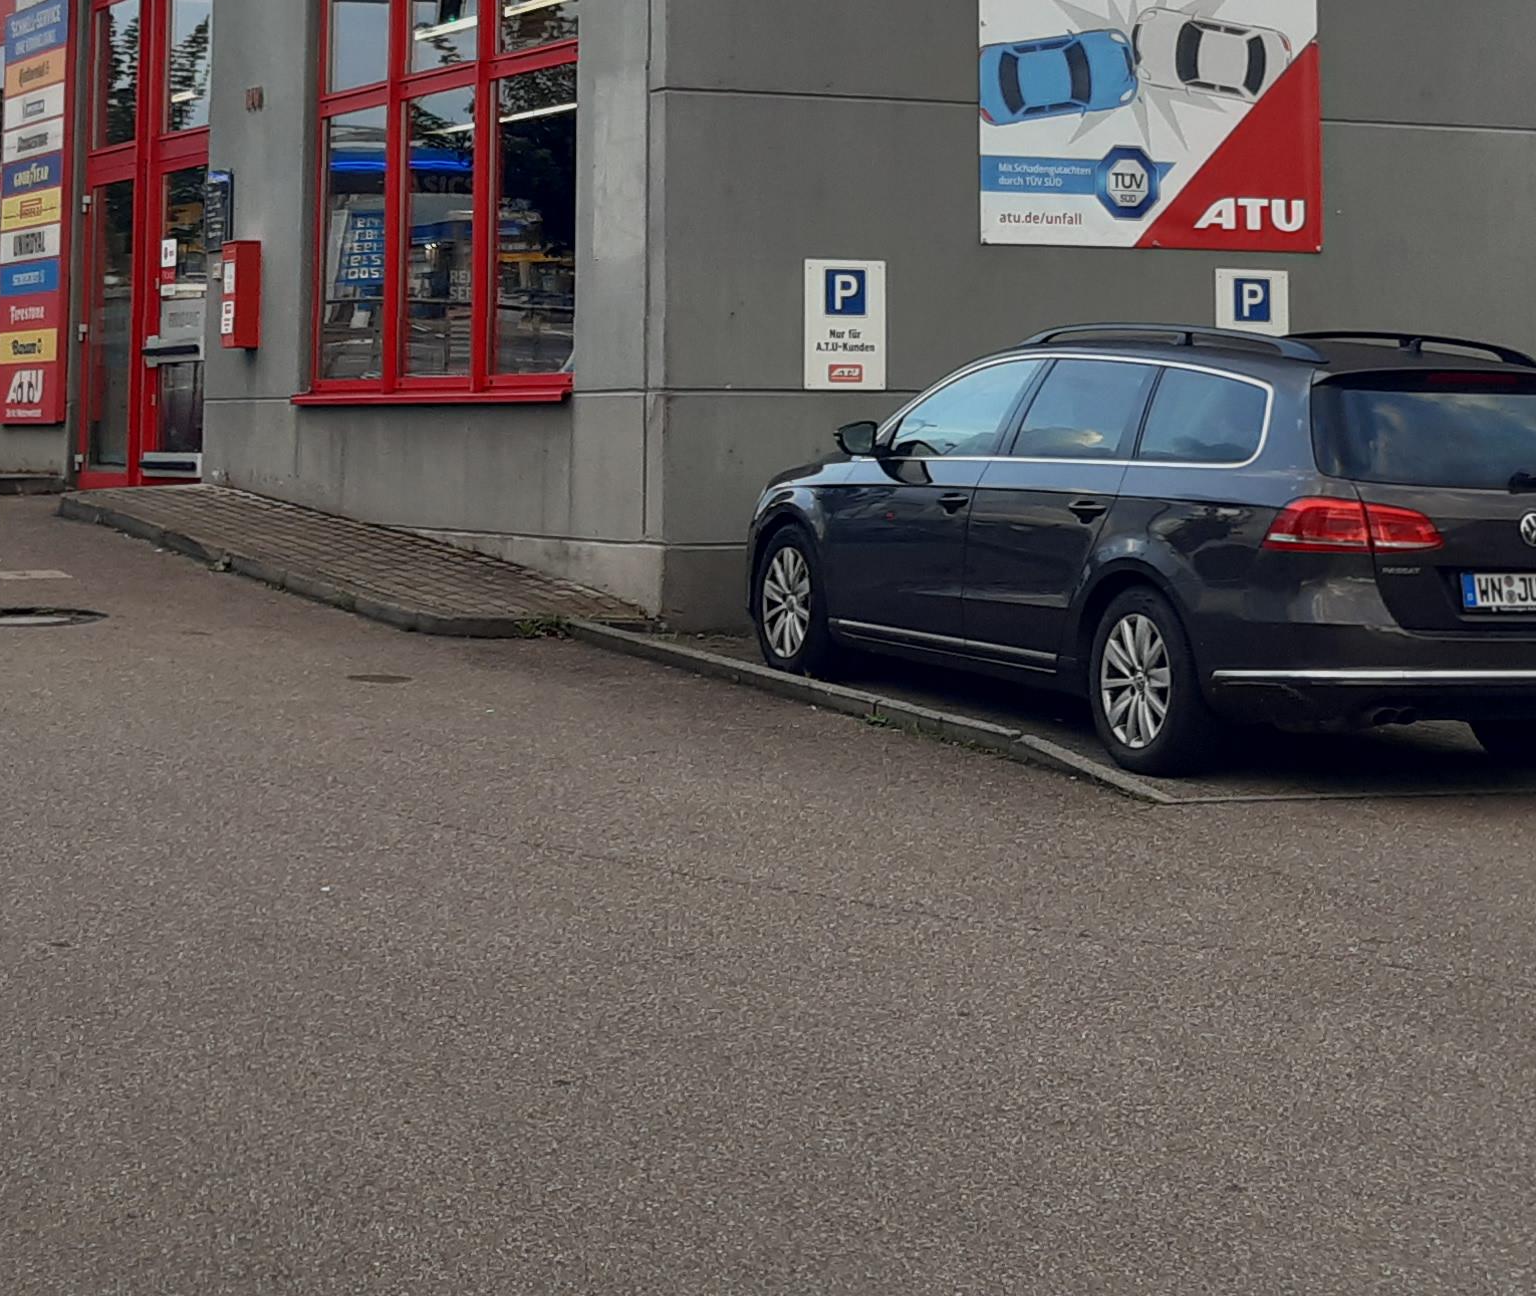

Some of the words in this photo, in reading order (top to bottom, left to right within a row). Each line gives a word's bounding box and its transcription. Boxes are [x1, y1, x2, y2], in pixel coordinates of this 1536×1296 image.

[999, 176, 1023, 185] durch
[1025, 176, 1042, 186] TÜV
[1111, 172, 1145, 189] TÜV
[999, 212, 1082, 225] atu.de/unfall
[1193, 198, 1305, 233] ATU
[834, 274, 859, 310] P
[1242, 283, 1264, 317] P
[829, 329, 845, 339] Nur
[848, 328, 862, 339] für
[1477, 577, 1504, 603] WN
